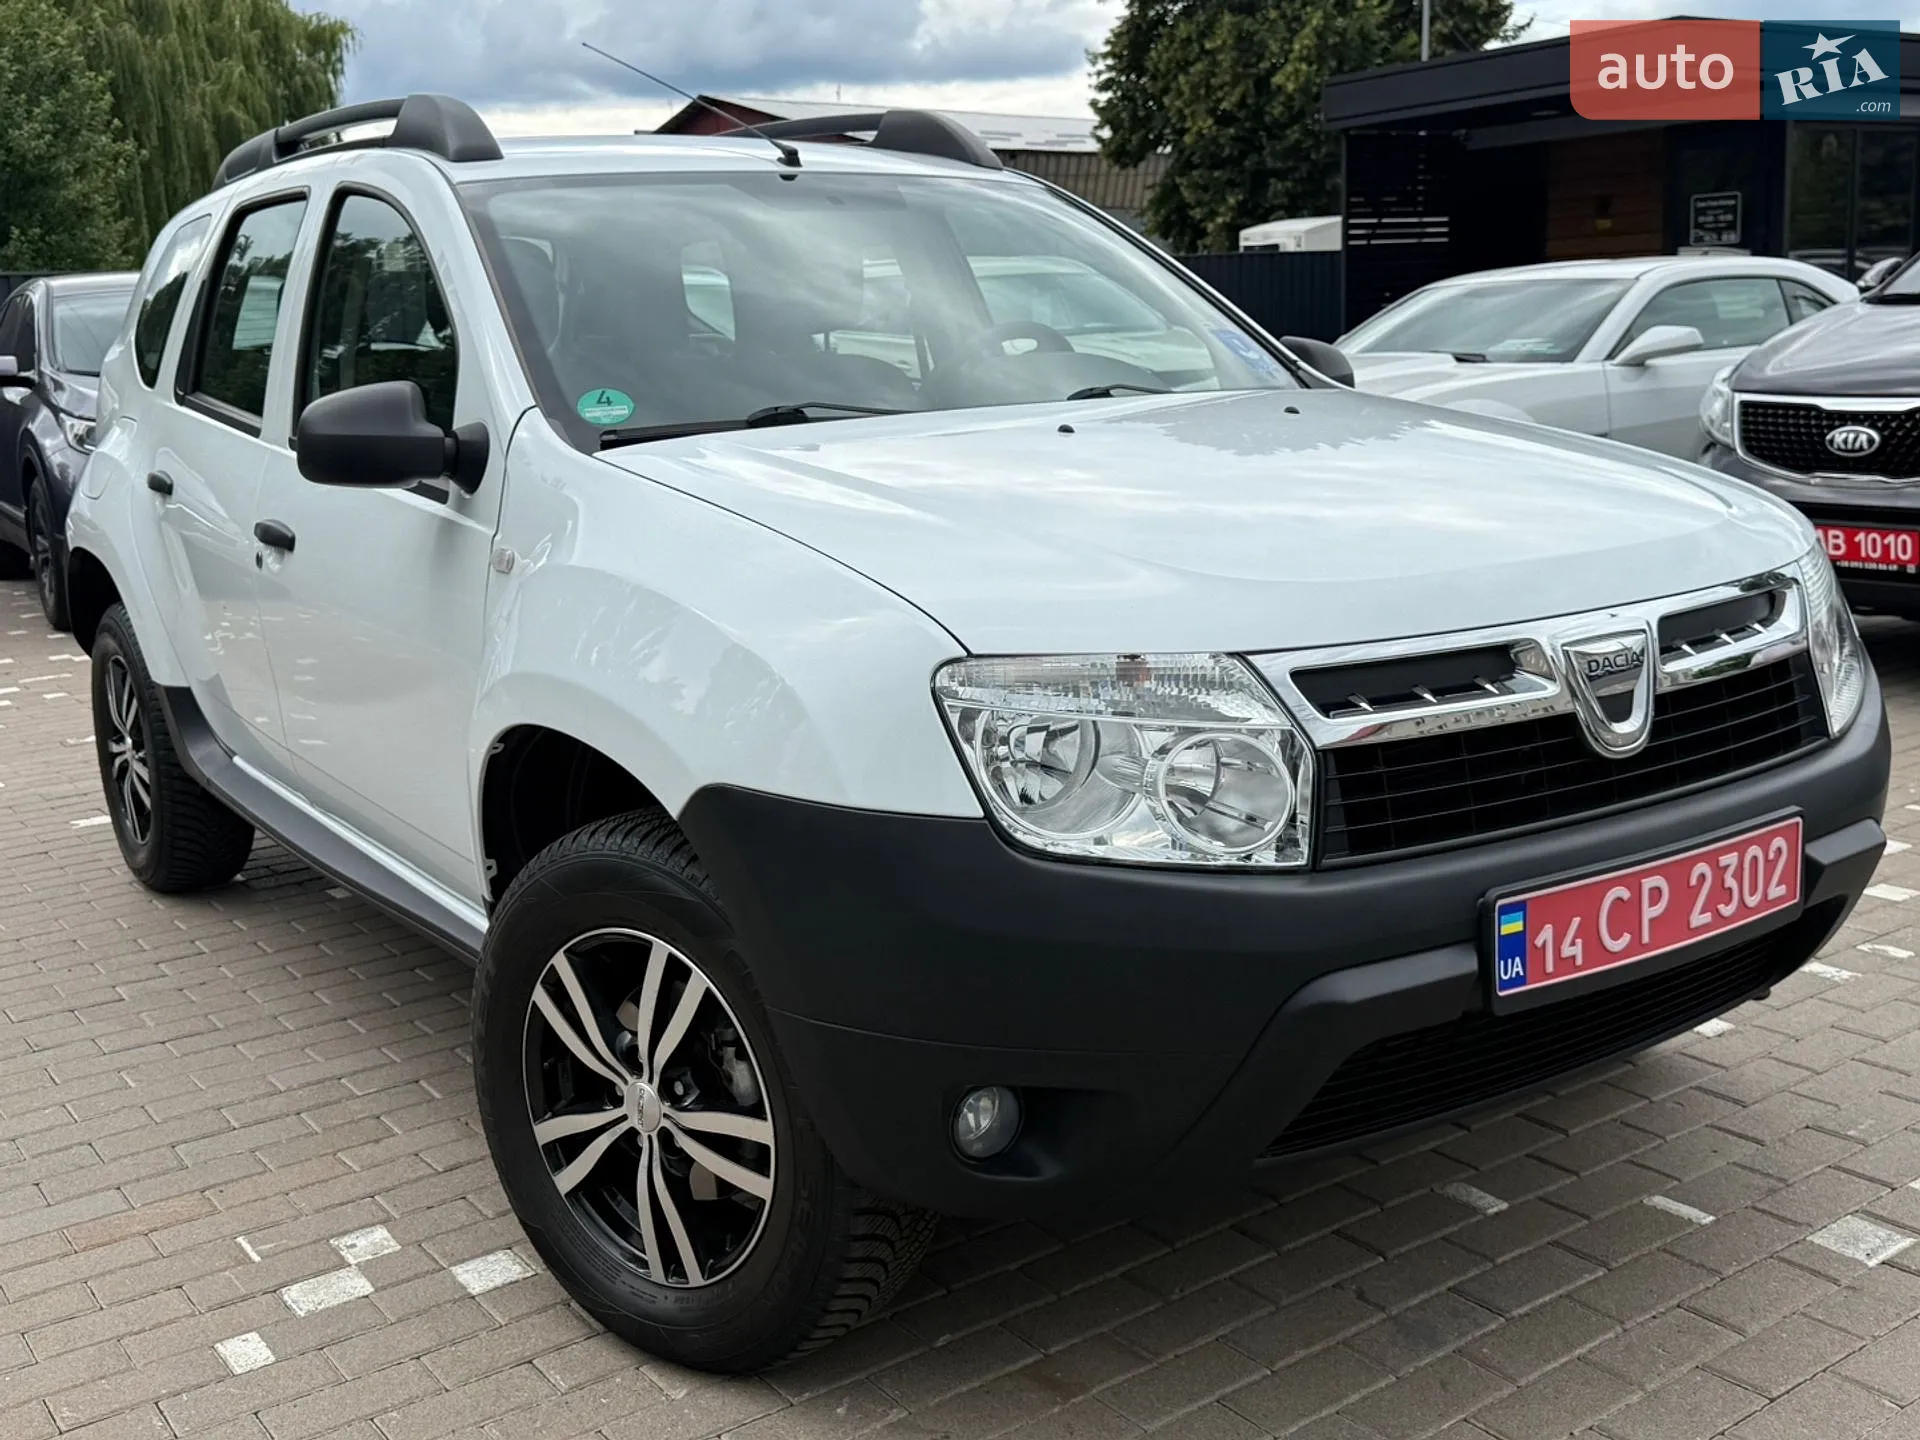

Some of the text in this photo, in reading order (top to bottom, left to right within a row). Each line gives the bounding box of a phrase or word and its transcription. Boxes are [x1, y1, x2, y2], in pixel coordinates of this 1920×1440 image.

[597, 391, 612, 405] 4
[1832, 432, 1869, 450] KIA
[1854, 531, 1913, 561] 1010
[1587, 651, 1645, 674] DACIA
[1534, 836, 1788, 973] 14 CP 2302
[1500, 958, 1523, 980] UA
